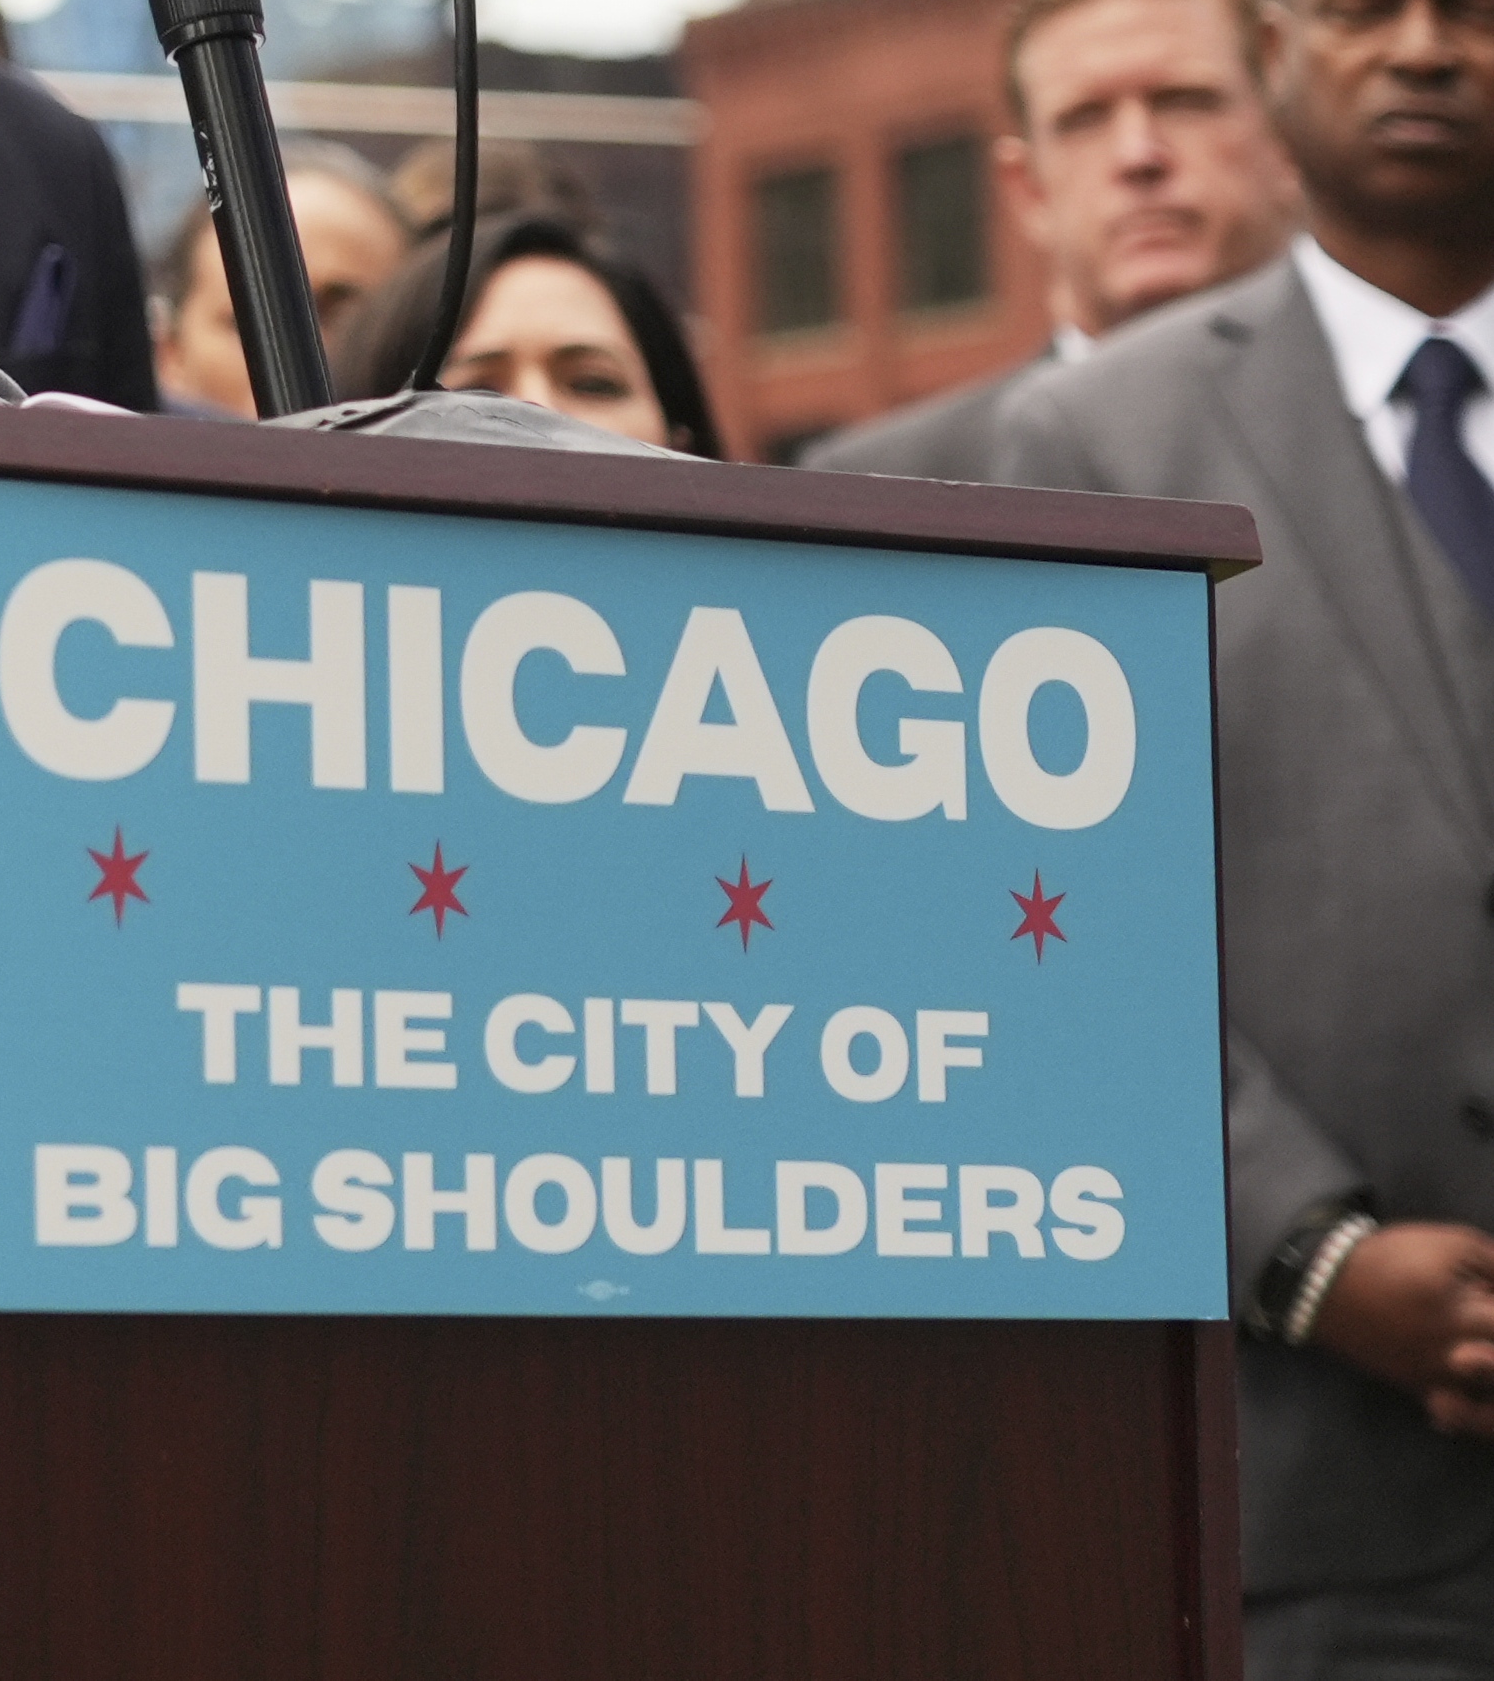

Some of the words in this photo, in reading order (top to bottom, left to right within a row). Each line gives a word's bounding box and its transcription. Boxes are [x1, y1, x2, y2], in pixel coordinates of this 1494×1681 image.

[176, 982, 458, 1090] THE
[484, 993, 794, 1098] CITY
[820, 1005, 989, 1103] OF
[34, 1143, 283, 1250] BIG
[311, 1149, 1126, 1261] SHOULDERS
